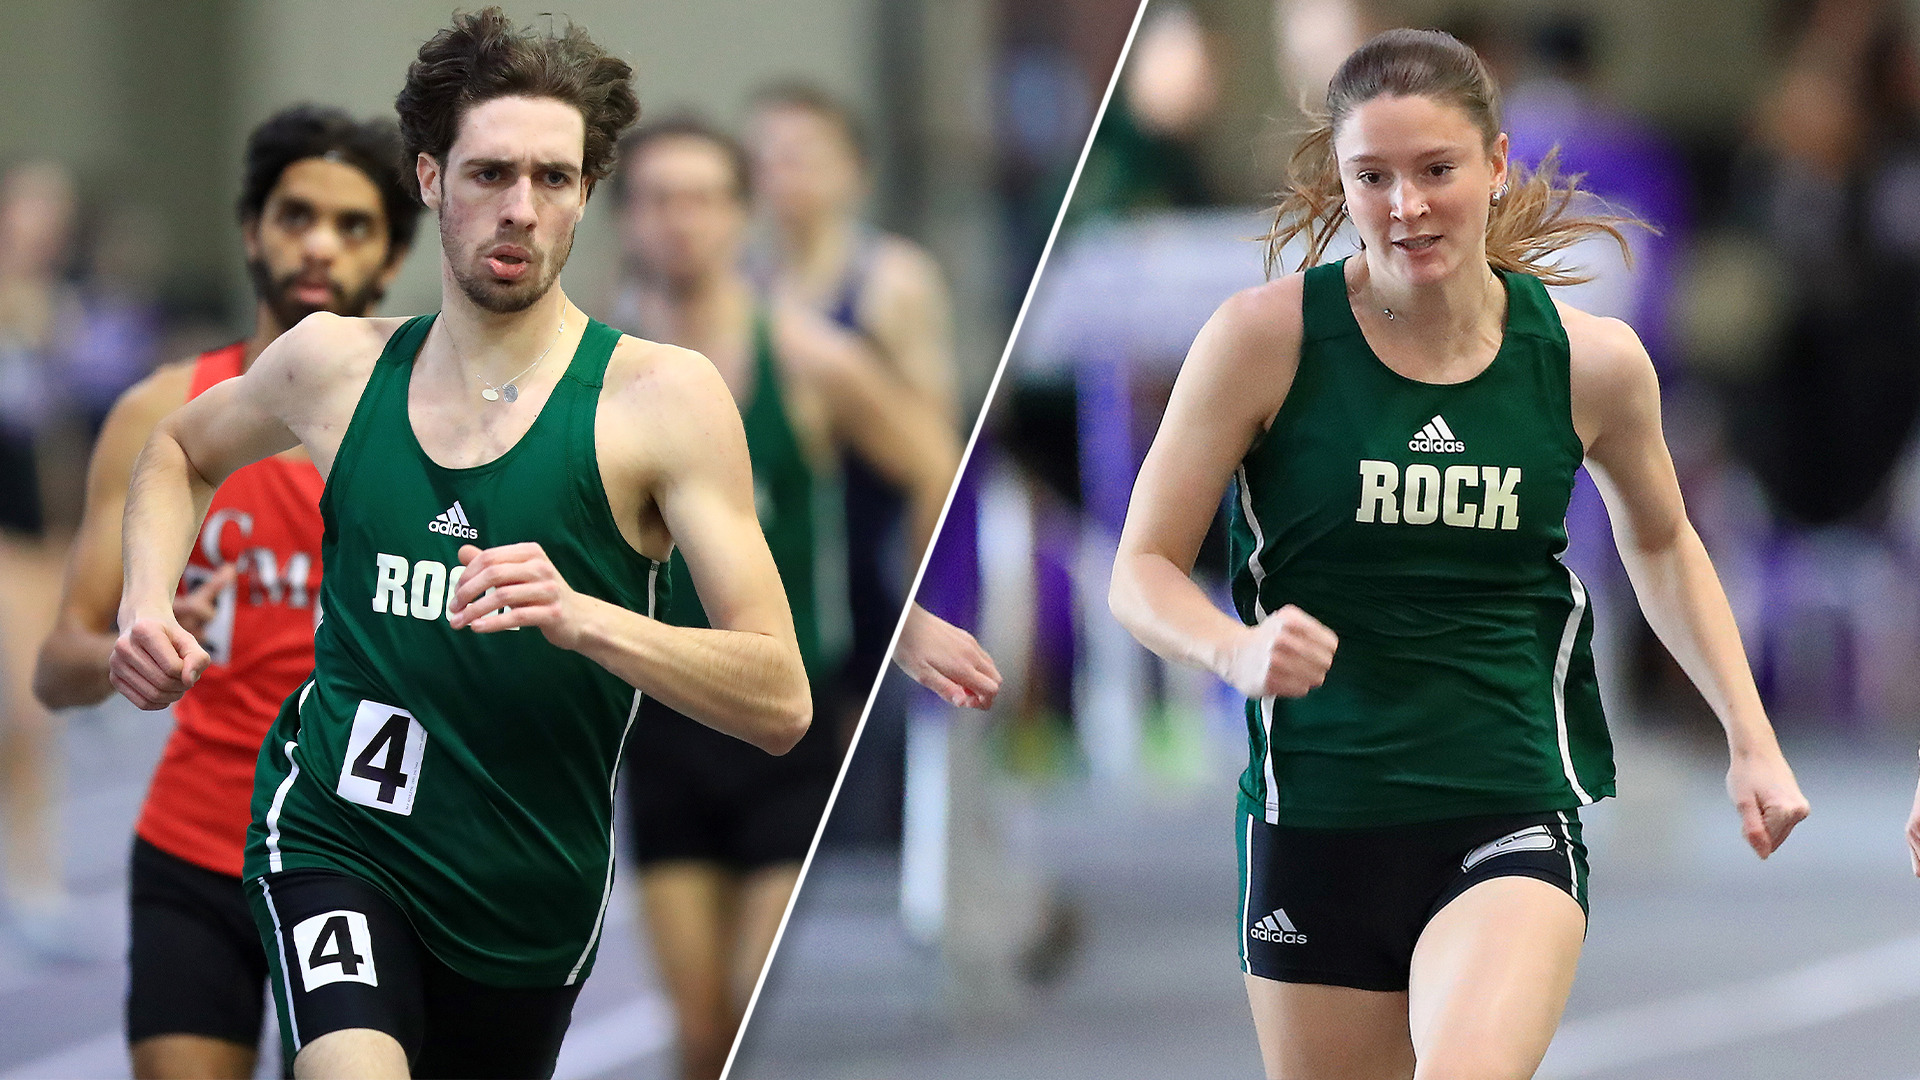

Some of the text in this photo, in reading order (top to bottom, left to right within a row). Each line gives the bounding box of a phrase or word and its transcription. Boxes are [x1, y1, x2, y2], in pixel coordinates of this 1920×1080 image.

[1408, 437, 1466, 453] adidas
[1355, 459, 1522, 530] ROCK
[428, 519, 478, 540] adidas
[372, 552, 521, 631] RO
[351, 713, 411, 805] 4
[308, 915, 365, 976] 4
[1250, 926, 1308, 945] adidas
